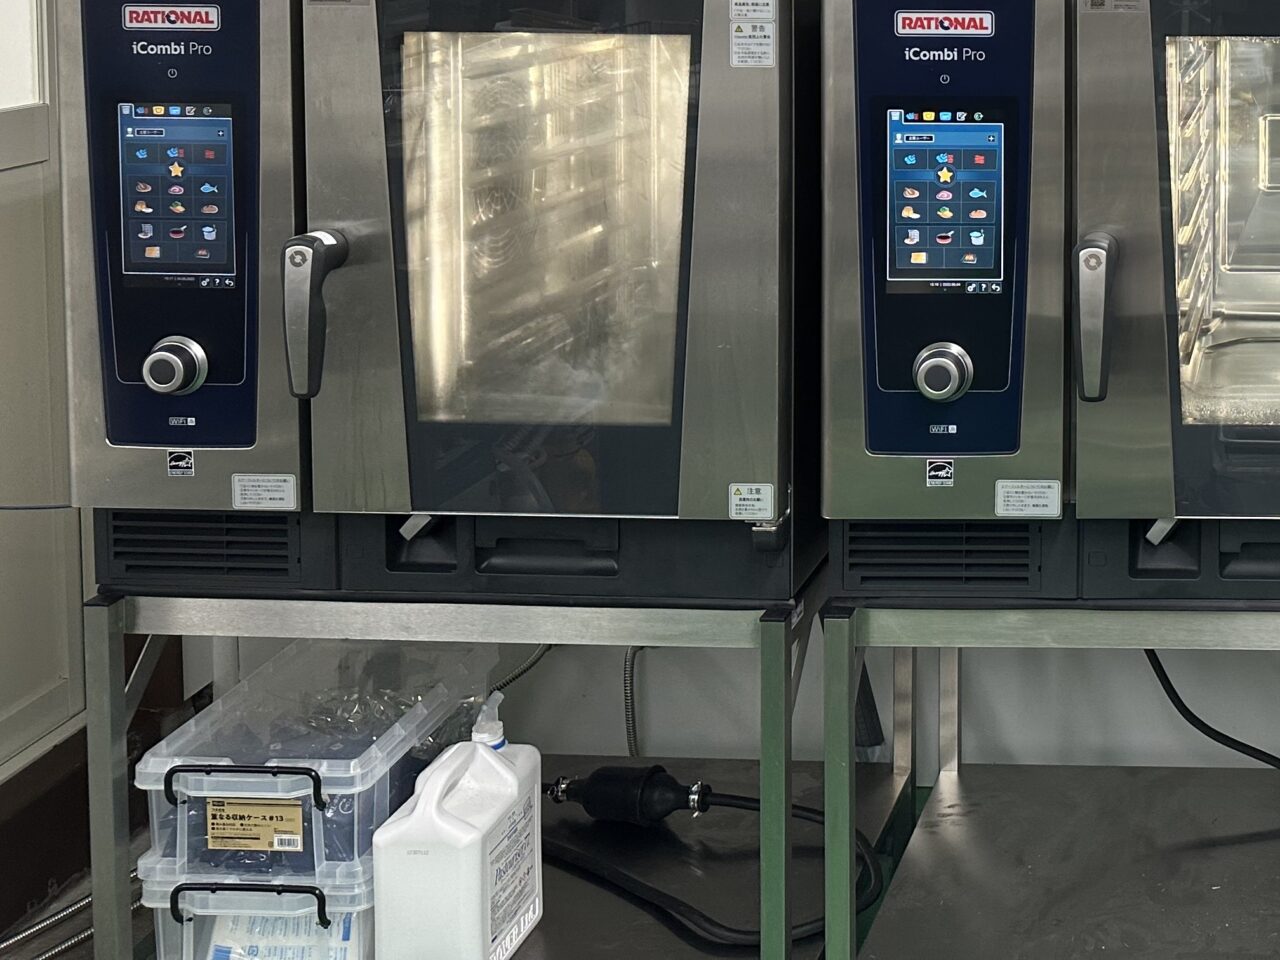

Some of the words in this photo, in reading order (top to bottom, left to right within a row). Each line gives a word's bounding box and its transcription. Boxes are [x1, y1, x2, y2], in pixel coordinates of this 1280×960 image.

[128, 10, 215, 25] RATIONAL
[901, 16, 989, 31] RATIONAL
[132, 41, 185, 55] iCombi
[189, 42, 212, 55] Pro
[904, 47, 958, 61] iCombi
[962, 48, 986, 61] Pro
